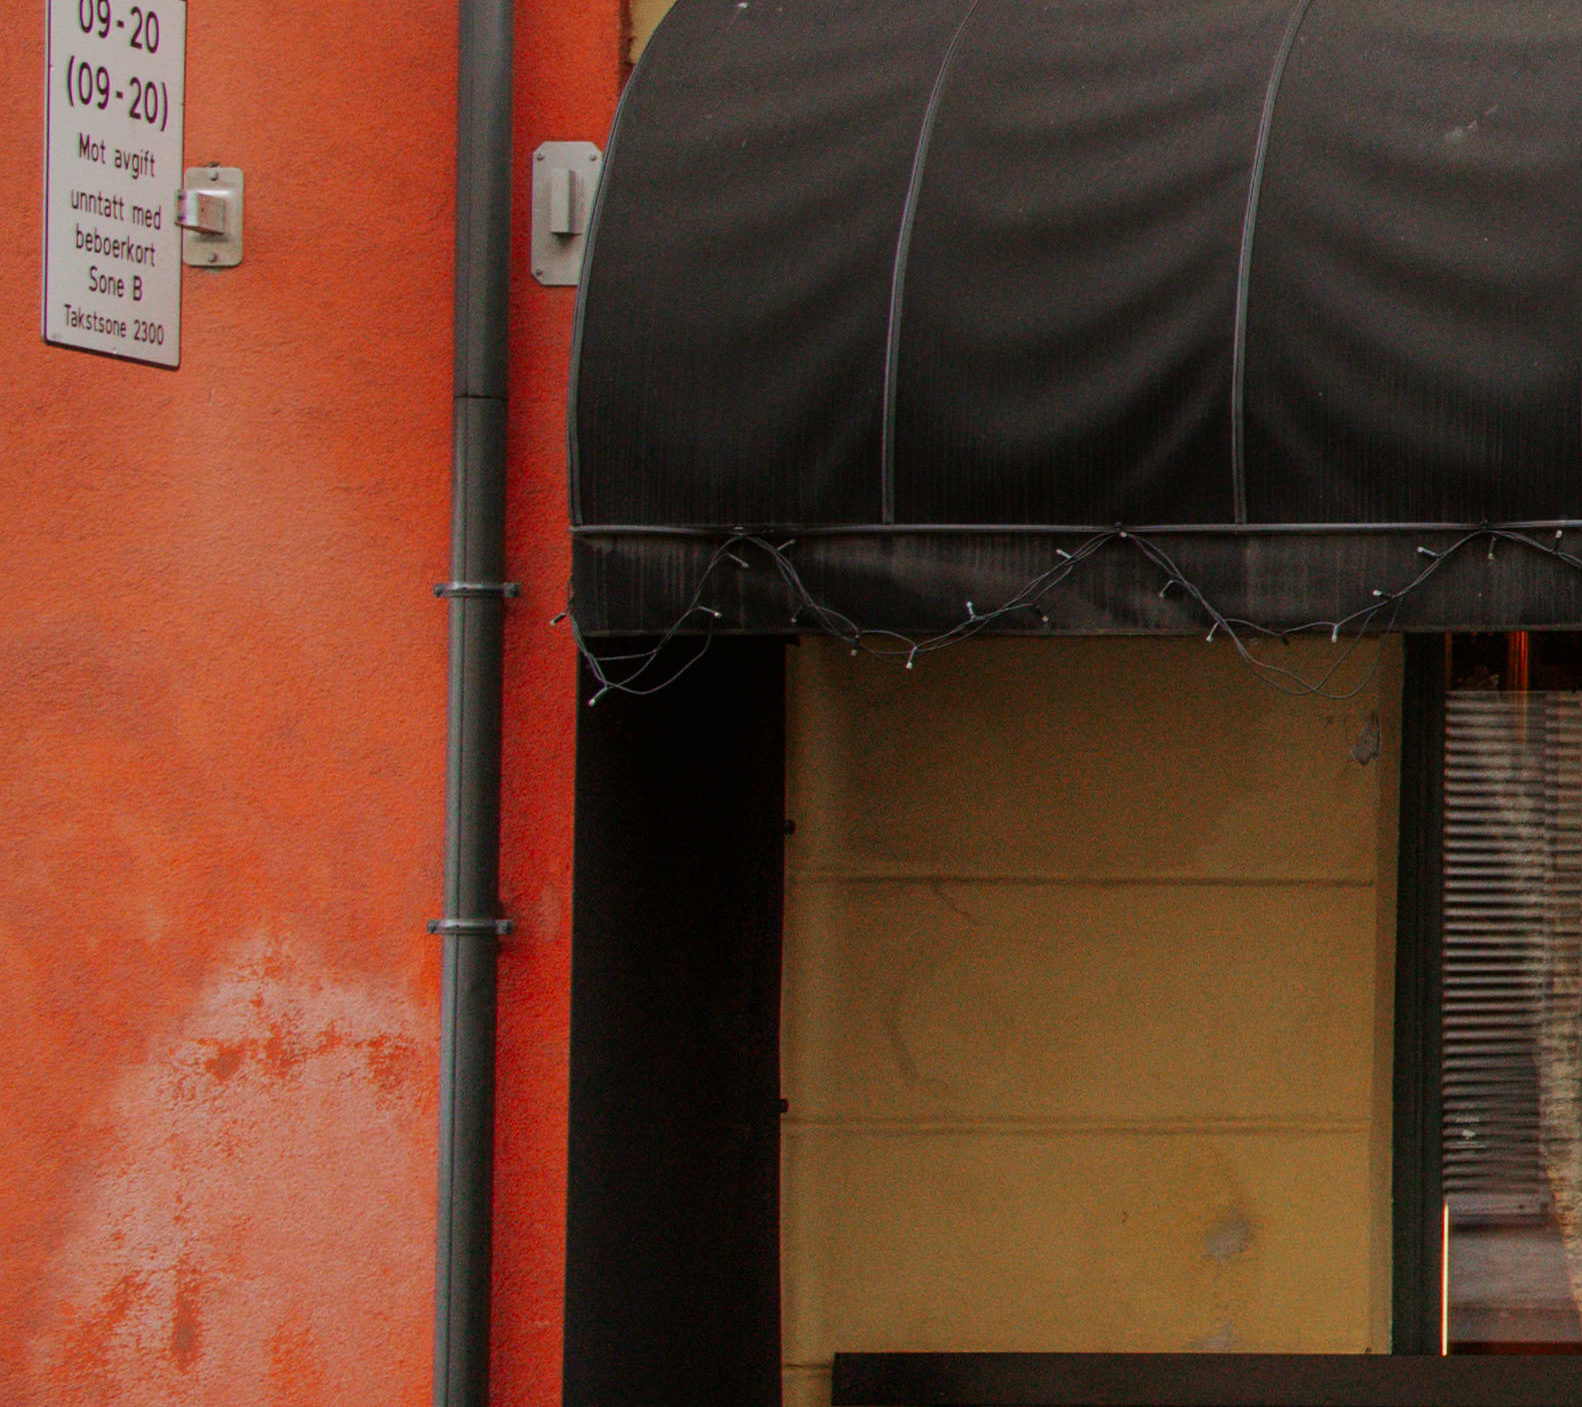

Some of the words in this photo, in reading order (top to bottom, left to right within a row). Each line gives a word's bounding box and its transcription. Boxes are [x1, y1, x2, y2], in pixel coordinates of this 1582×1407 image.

[66, 55, 169, 133] (09-20)
[79, 133, 106, 165] Mot
[114, 147, 156, 180] avgift
[71, 190, 125, 222] unntatt
[132, 205, 161, 231] med
[76, 224, 156, 267] beboerkort
[88, 265, 124, 298] Sone
[132, 275, 144, 302] B
[64, 304, 128, 340] Takstsone
[133, 319, 165, 346] 2300
